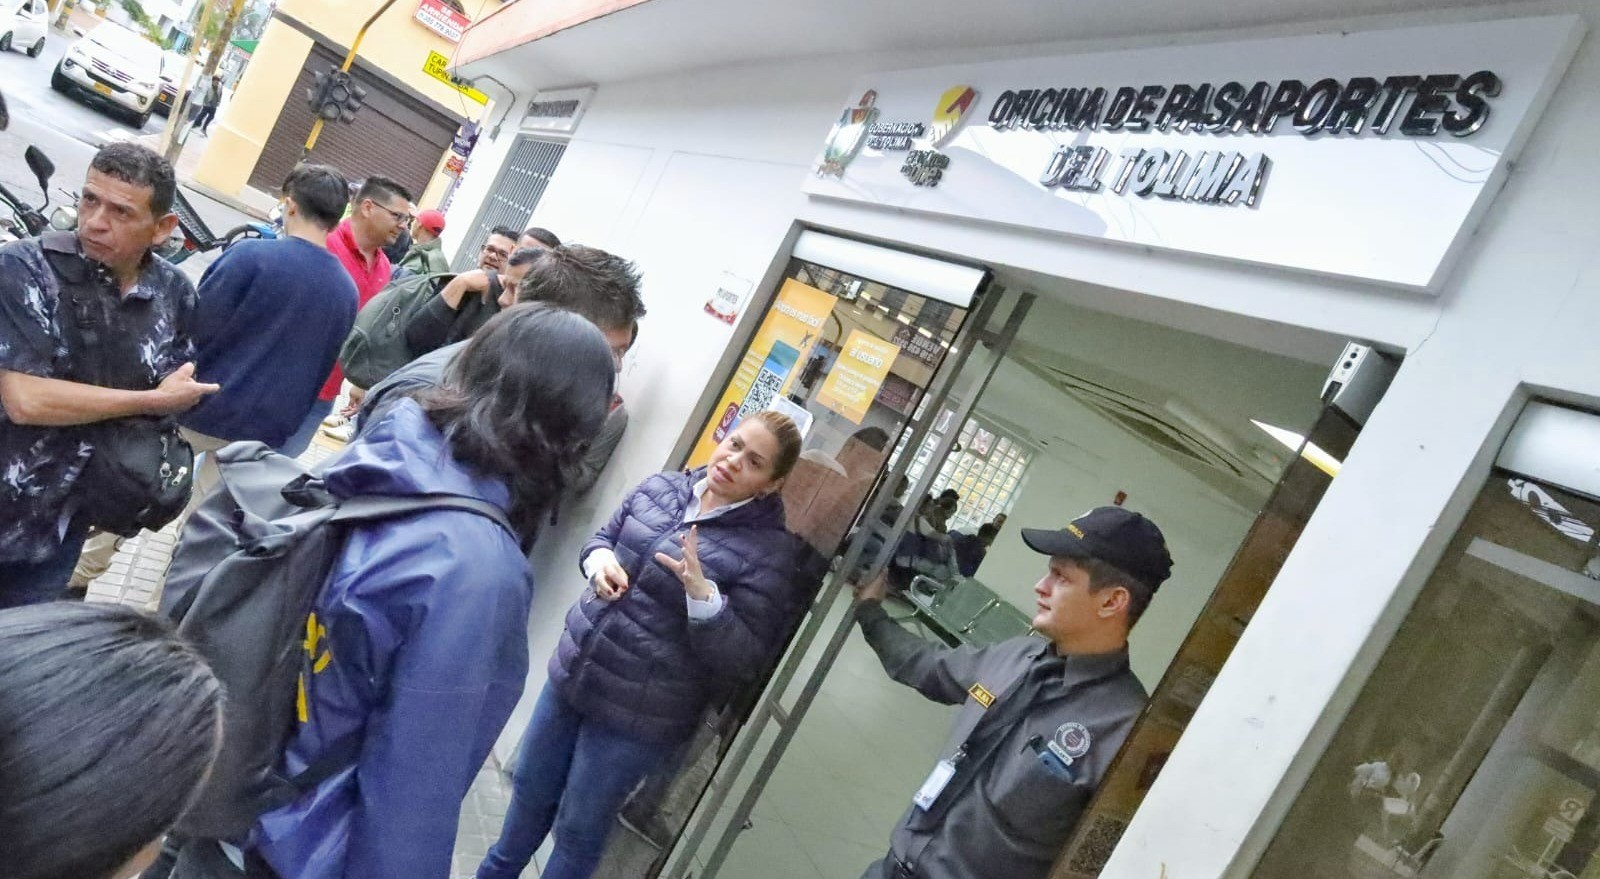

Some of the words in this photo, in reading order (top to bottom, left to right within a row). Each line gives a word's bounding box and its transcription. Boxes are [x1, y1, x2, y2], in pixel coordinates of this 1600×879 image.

[421, 4, 465, 33] ARRIENDA
[988, 86, 1107, 131] OFICINA
[1102, 85, 1166, 131] DE
[1155, 70, 1501, 137] PASAPORTES
[1039, 144, 1111, 190] DEL
[1111, 147, 1269, 208] TOLIMA
